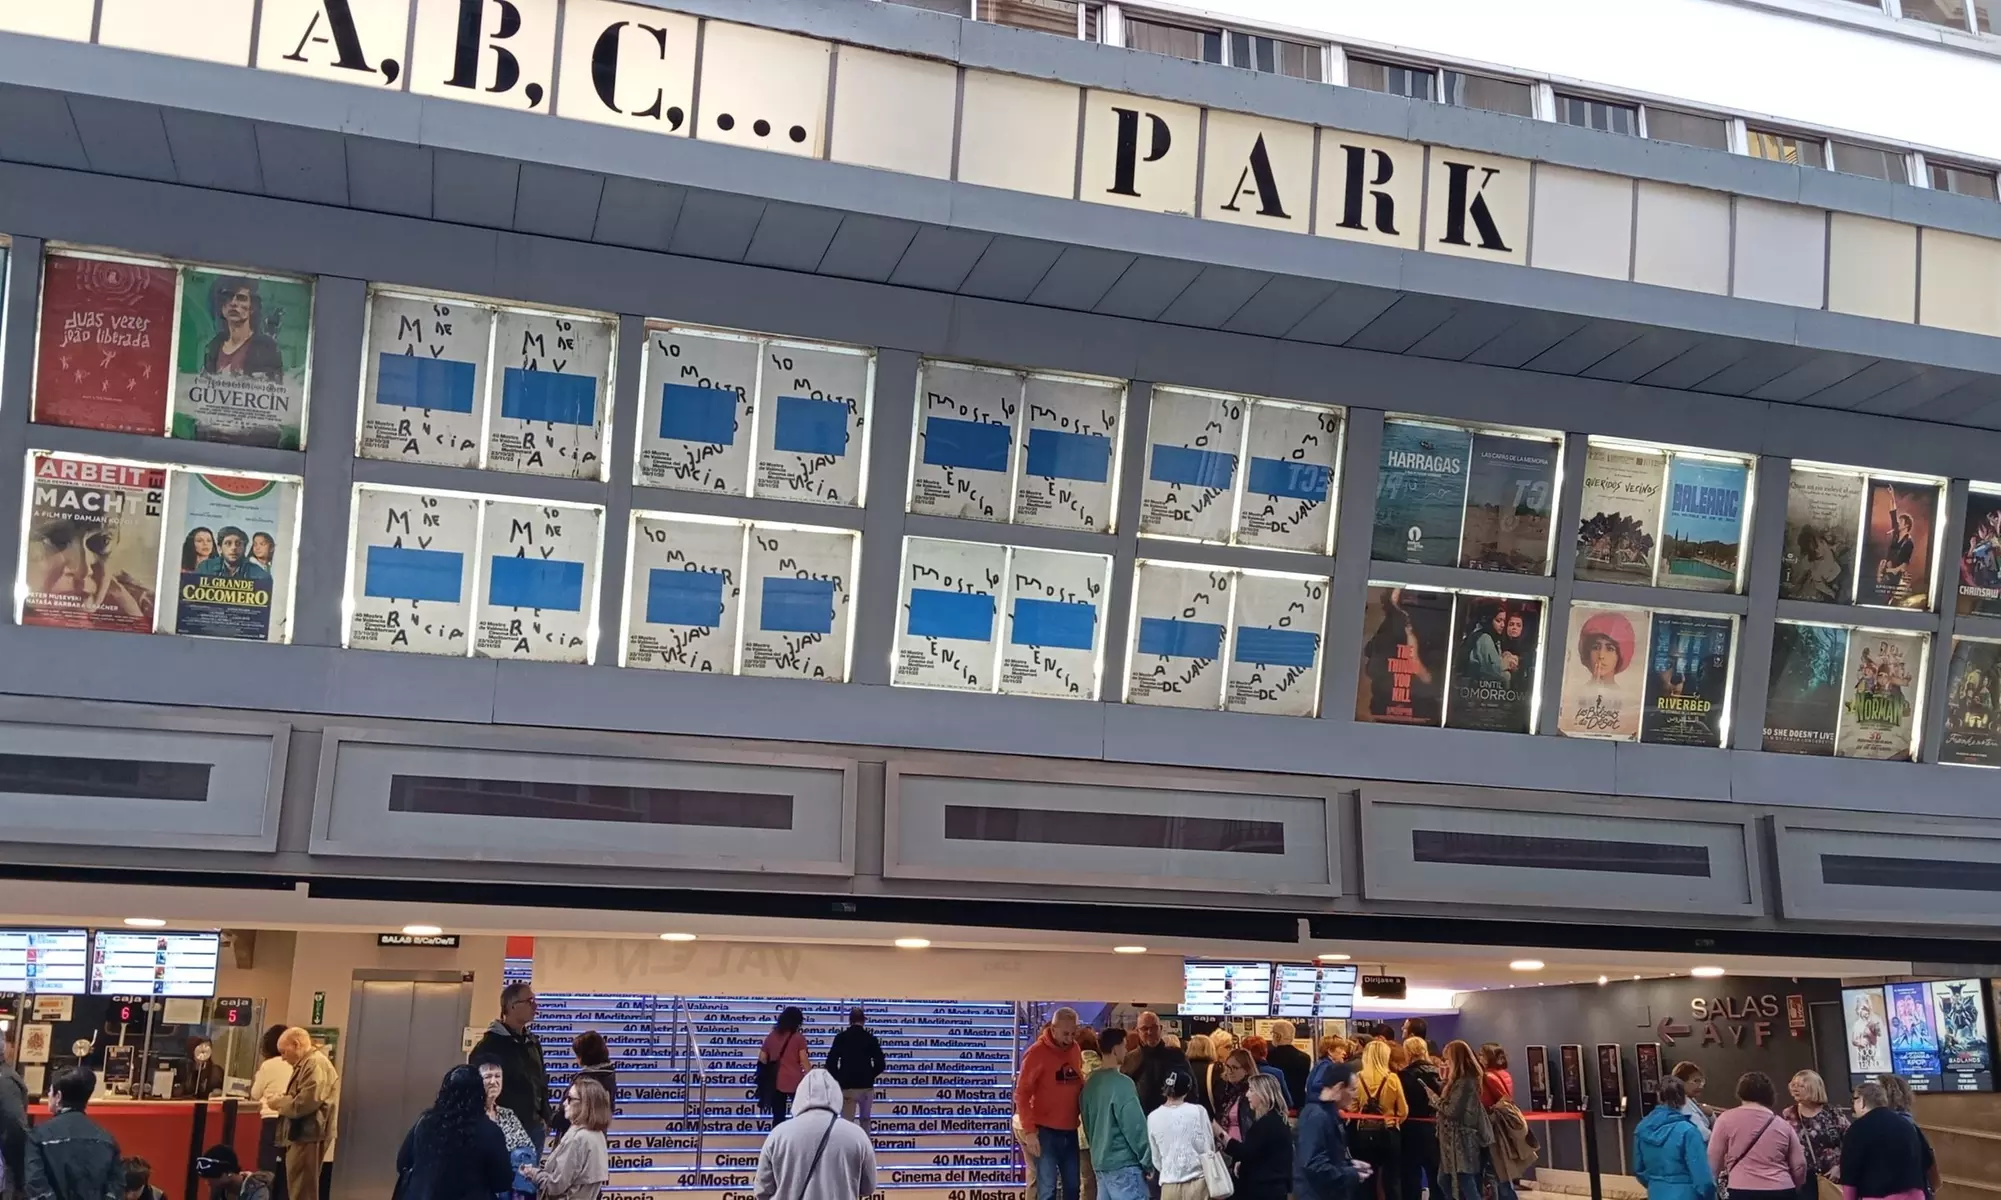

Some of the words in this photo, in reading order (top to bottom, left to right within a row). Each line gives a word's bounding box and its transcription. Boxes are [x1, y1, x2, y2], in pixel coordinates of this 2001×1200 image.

[1106, 106, 1513, 252] PARK
[64, 311, 103, 329] duas
[111, 314, 151, 330] vezes
[60, 328, 89, 348] joão
[96, 328, 150, 348] liberada
[1388, 450, 1460, 474] HARRAGAS
[38, 459, 146, 486] ARBEIT
[146, 470, 164, 517] FREI
[35, 487, 142, 515] MACHT
[1672, 483, 1739, 518] BALEARIC
[74, 514, 107, 523] DAMJAN
[200, 576, 209, 587] IL
[211, 578, 254, 591] GRANDE
[183, 585, 268, 605] COCOMERO
[1959, 585, 1998, 598] CHAINSAW
[1479, 680, 1502, 690] UNTIL
[1459, 687, 1525, 702] OMORROW
[1657, 697, 1711, 712] RIVERBED
[1773, 728, 1788, 736] SHE
[1789, 730, 1818, 739] DOESN'T
[1820, 732, 1835, 740] LIVE
[112, 994, 142, 1003] caja
[220, 998, 249, 1007] caja
[121, 1007, 130, 1019] 6
[1691, 994, 1779, 1020] SALAS
[228, 1010, 237, 1022] 5
[526, 1023, 572, 1031] diterrani
[1728, 1025, 1742, 1046] Y
[1755, 1022, 1771, 1046] F
[911, 1076, 928, 1085] del
[936, 1089, 951, 1099] 40
[955, 1089, 996, 1099] Mostra
[736, 1104, 755, 1115] del
[892, 1105, 908, 1115] 40
[911, 1105, 953, 1115] Mostra
[957, 1105, 971, 1115] de
[973, 1105, 1012, 1115] Valènc
[665, 1121, 683, 1132] 40
[736, 1121, 753, 1132] de
[870, 1120, 916, 1131] Cinema
[919, 1120, 937, 1131] del
[941, 1120, 1010, 1131] Mediterrani
[625, 1137, 641, 1148] de
[870, 1137, 916, 1148] iterrani
[974, 1136, 990, 1147] 40
[715, 1154, 759, 1167] Cinem
[933, 1154, 949, 1165] 40
[953, 1154, 998, 1165] Mostra
[678, 1174, 696, 1186] 40
[701, 1174, 752, 1186] Mostra
[892, 1172, 941, 1183] Cinema
[945, 1171, 964, 1182] del
